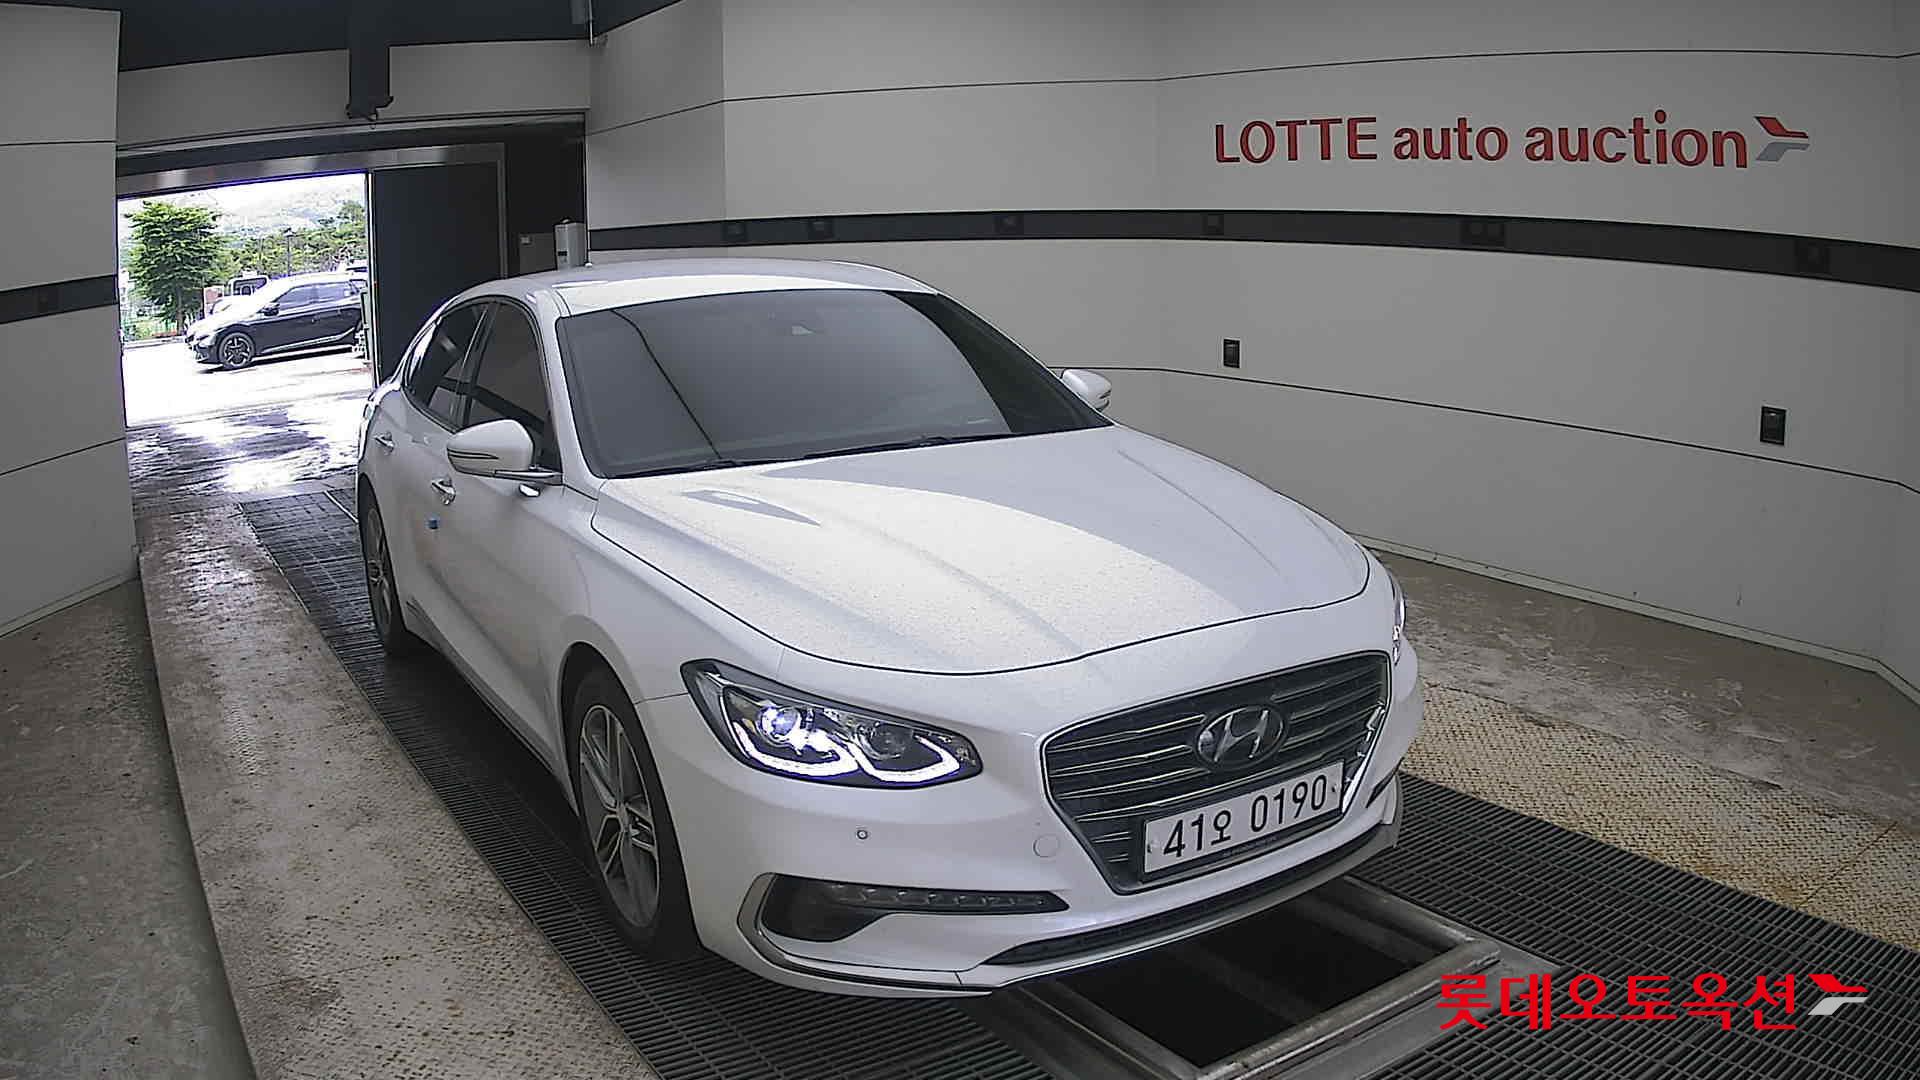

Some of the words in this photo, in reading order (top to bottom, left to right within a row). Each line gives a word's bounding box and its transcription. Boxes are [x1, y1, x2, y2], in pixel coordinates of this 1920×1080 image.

[1214, 116, 1378, 164] LOTTE
[1393, 116, 1509, 161] auto
[1524, 109, 1749, 169] auction
[1163, 810, 1232, 858] 41오
[1250, 774, 1328, 833] 0190
